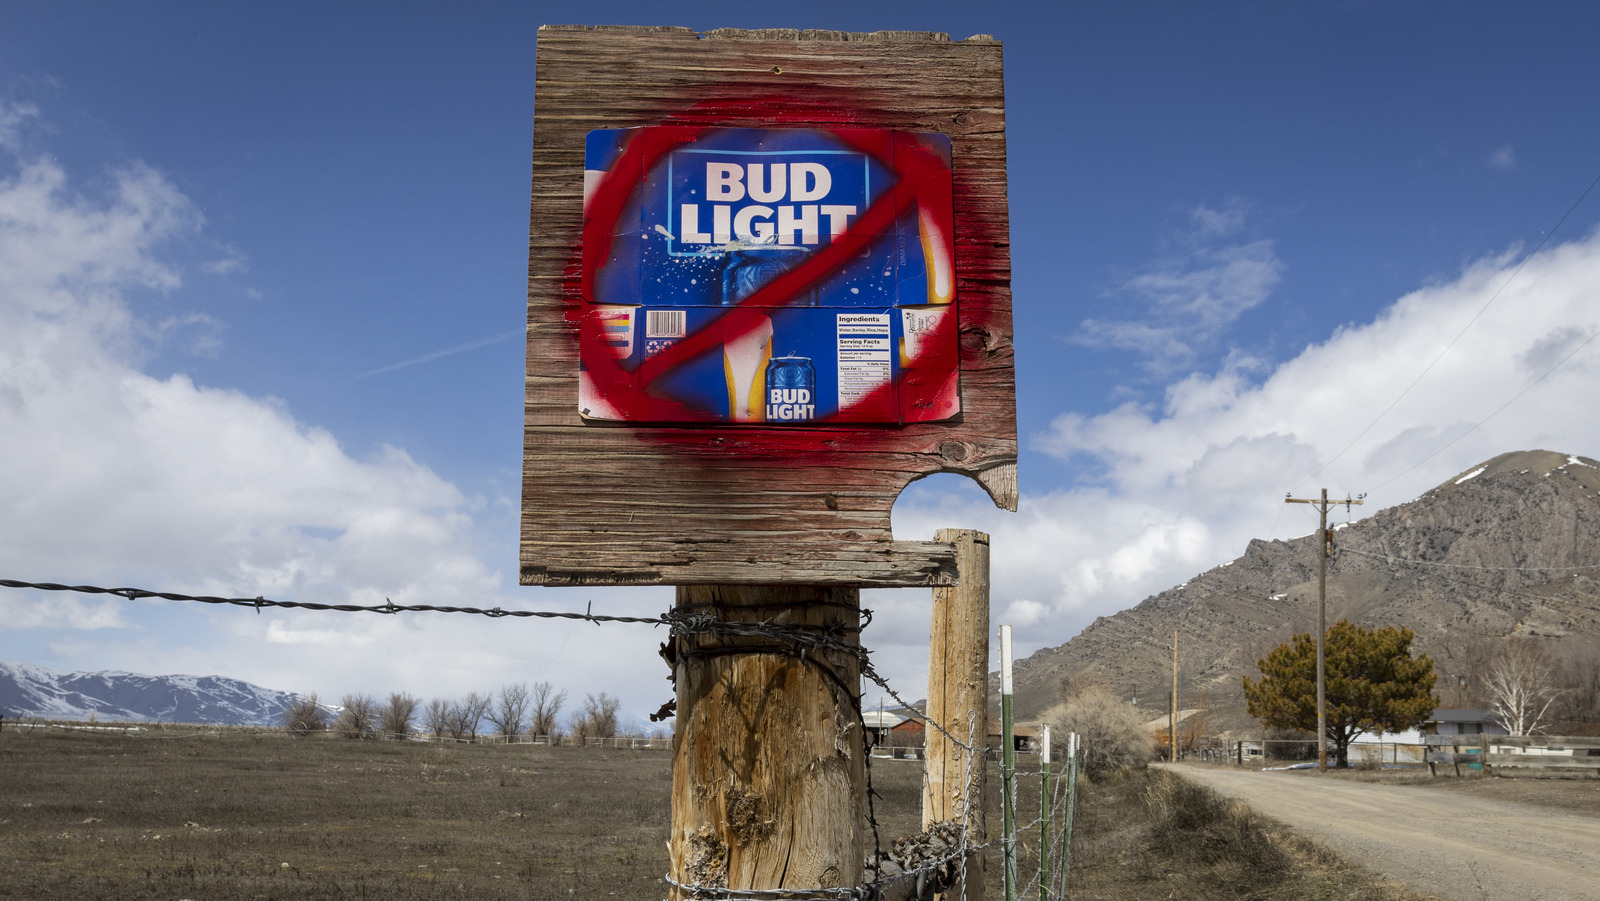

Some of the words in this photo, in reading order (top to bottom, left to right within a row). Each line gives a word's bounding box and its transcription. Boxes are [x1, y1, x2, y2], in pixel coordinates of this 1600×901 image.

[706, 162, 832, 203] BUD
[681, 204, 857, 245] LIGHT
[771, 389, 811, 404] BUD
[766, 404, 815, 420] LIGHT
